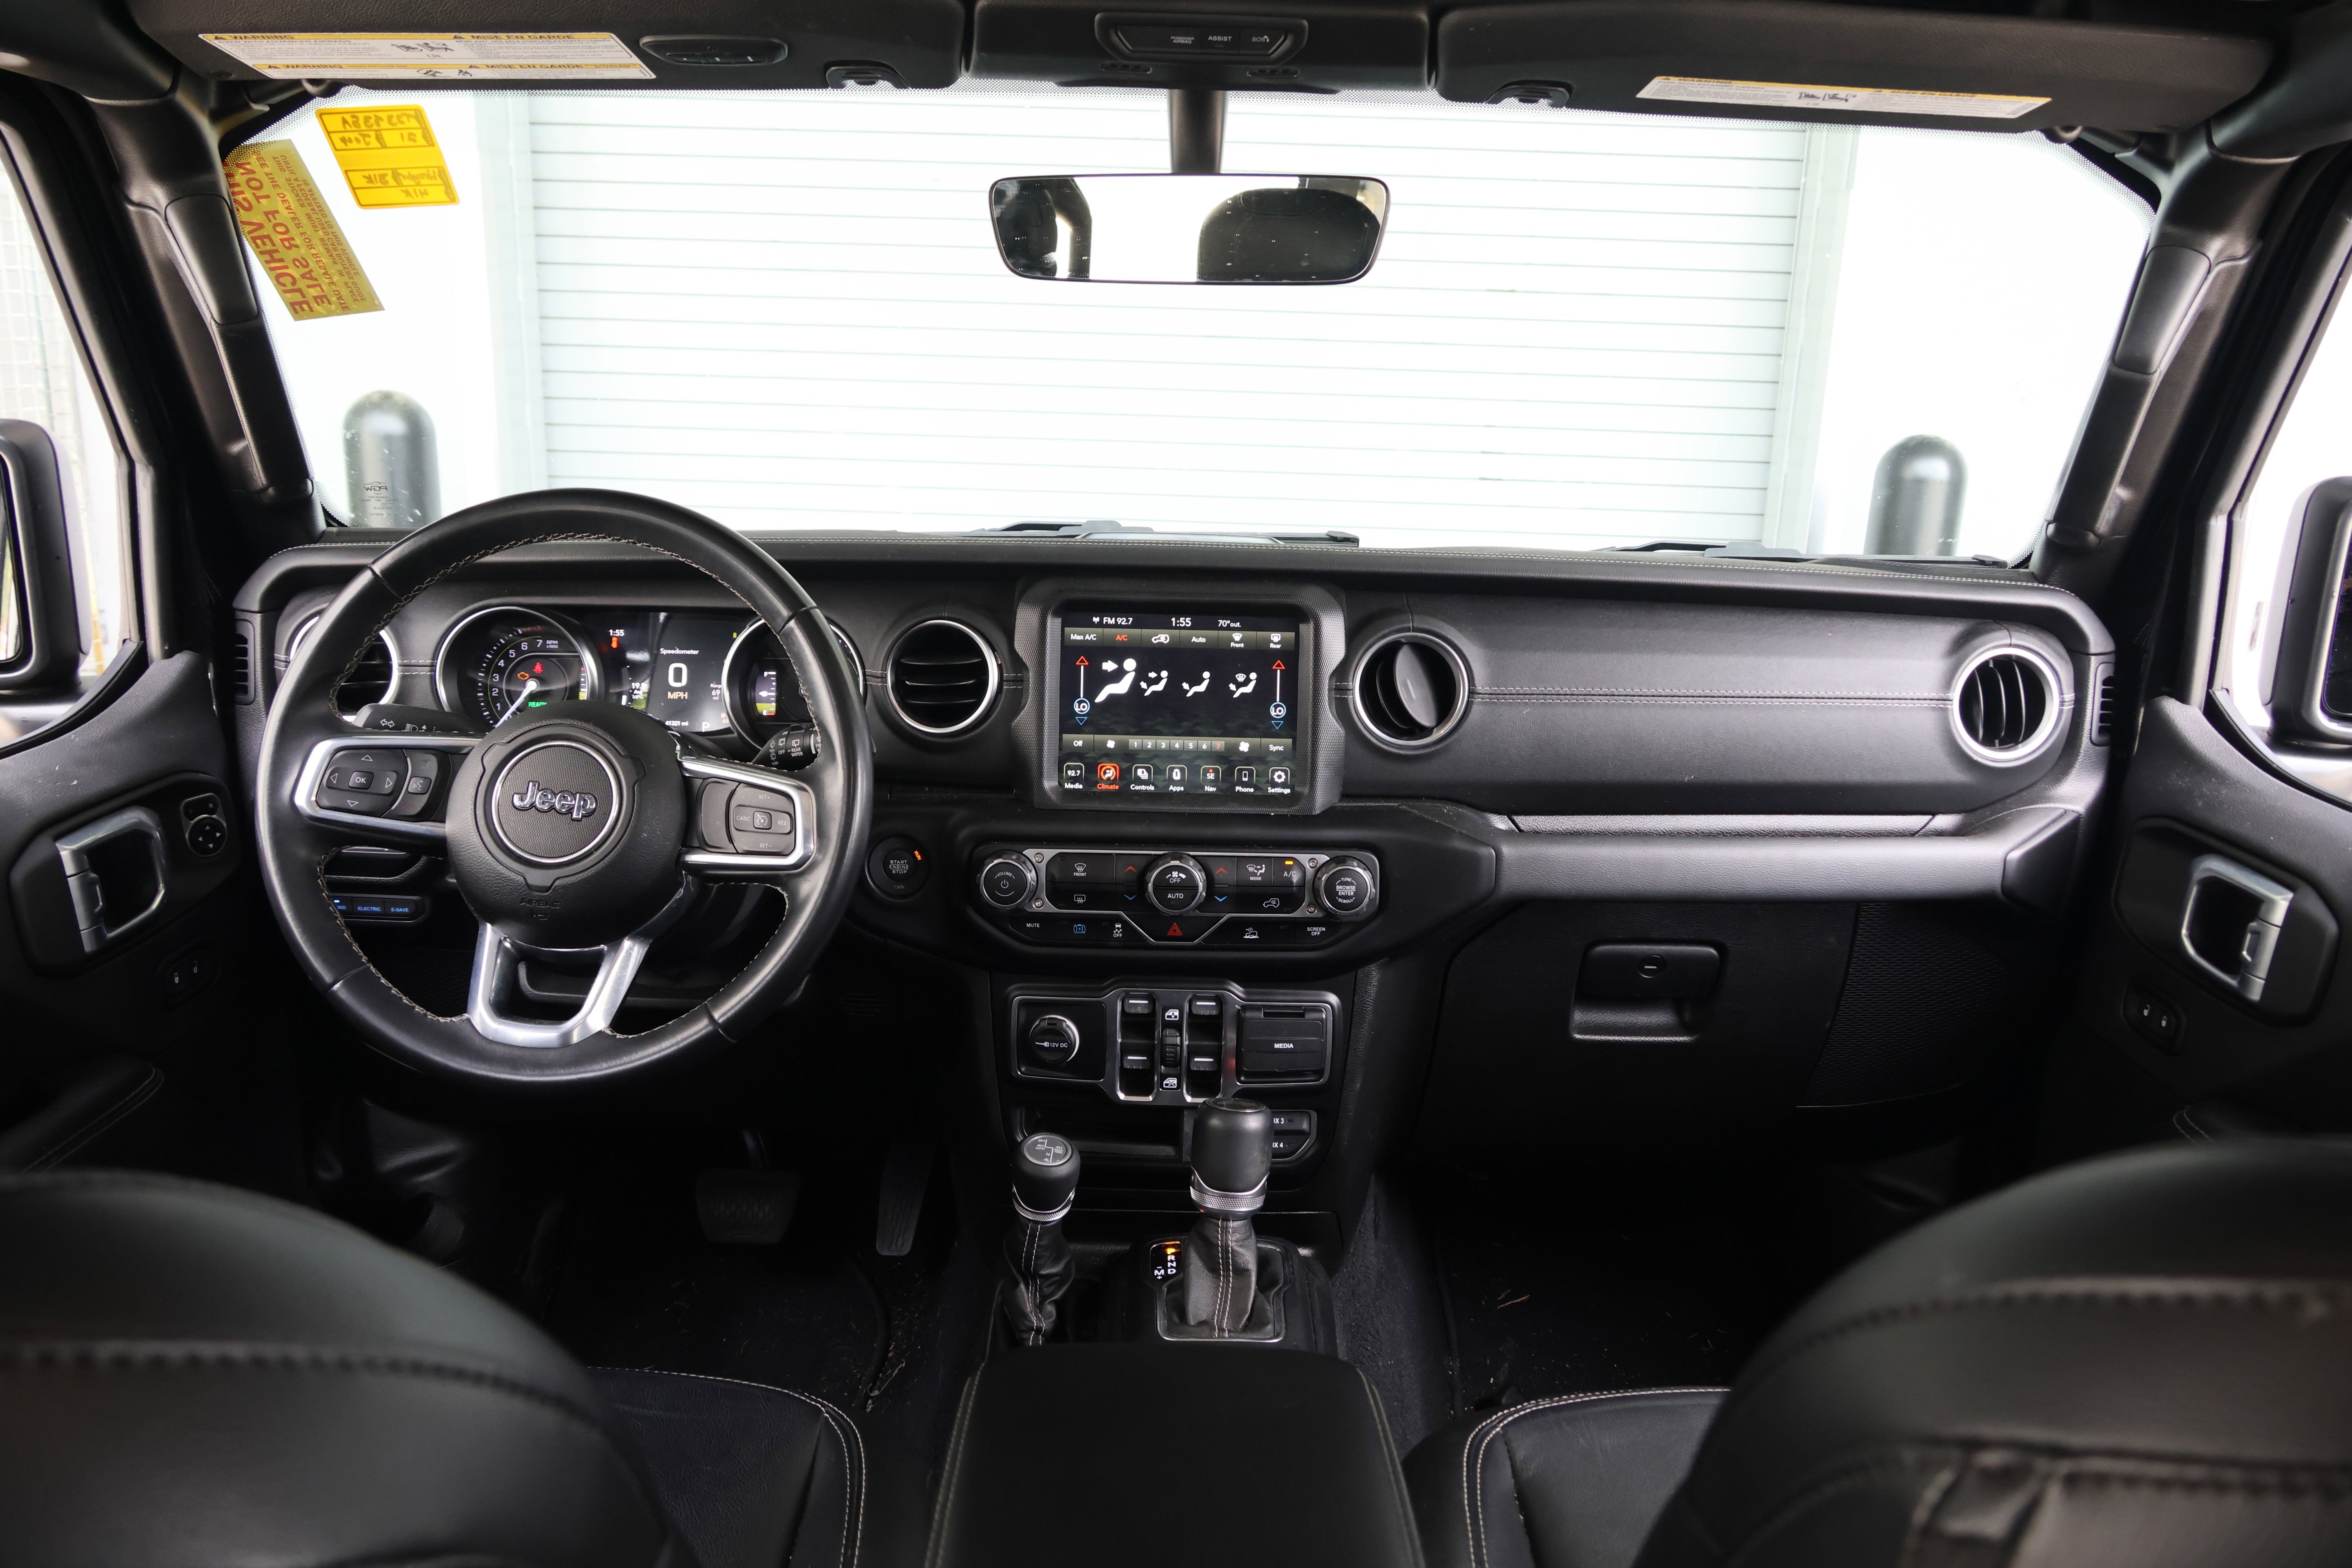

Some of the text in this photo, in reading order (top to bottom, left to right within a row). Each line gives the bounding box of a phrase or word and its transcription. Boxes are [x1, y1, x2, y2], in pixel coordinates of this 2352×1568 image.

[1172, 617, 1192, 627] 1:55
[660, 648, 699, 656] Speedometer
[668, 663, 687, 687] 0
[668, 691, 688, 699] MPH
[1076, 703, 1088, 711] LO
[1272, 706, 1284, 715] LO
[702, 722, 710, 732] P
[1269, 744, 1284, 753] Sync
[1097, 782, 1119, 791] Climate
[512, 781, 598, 821] Jeep
